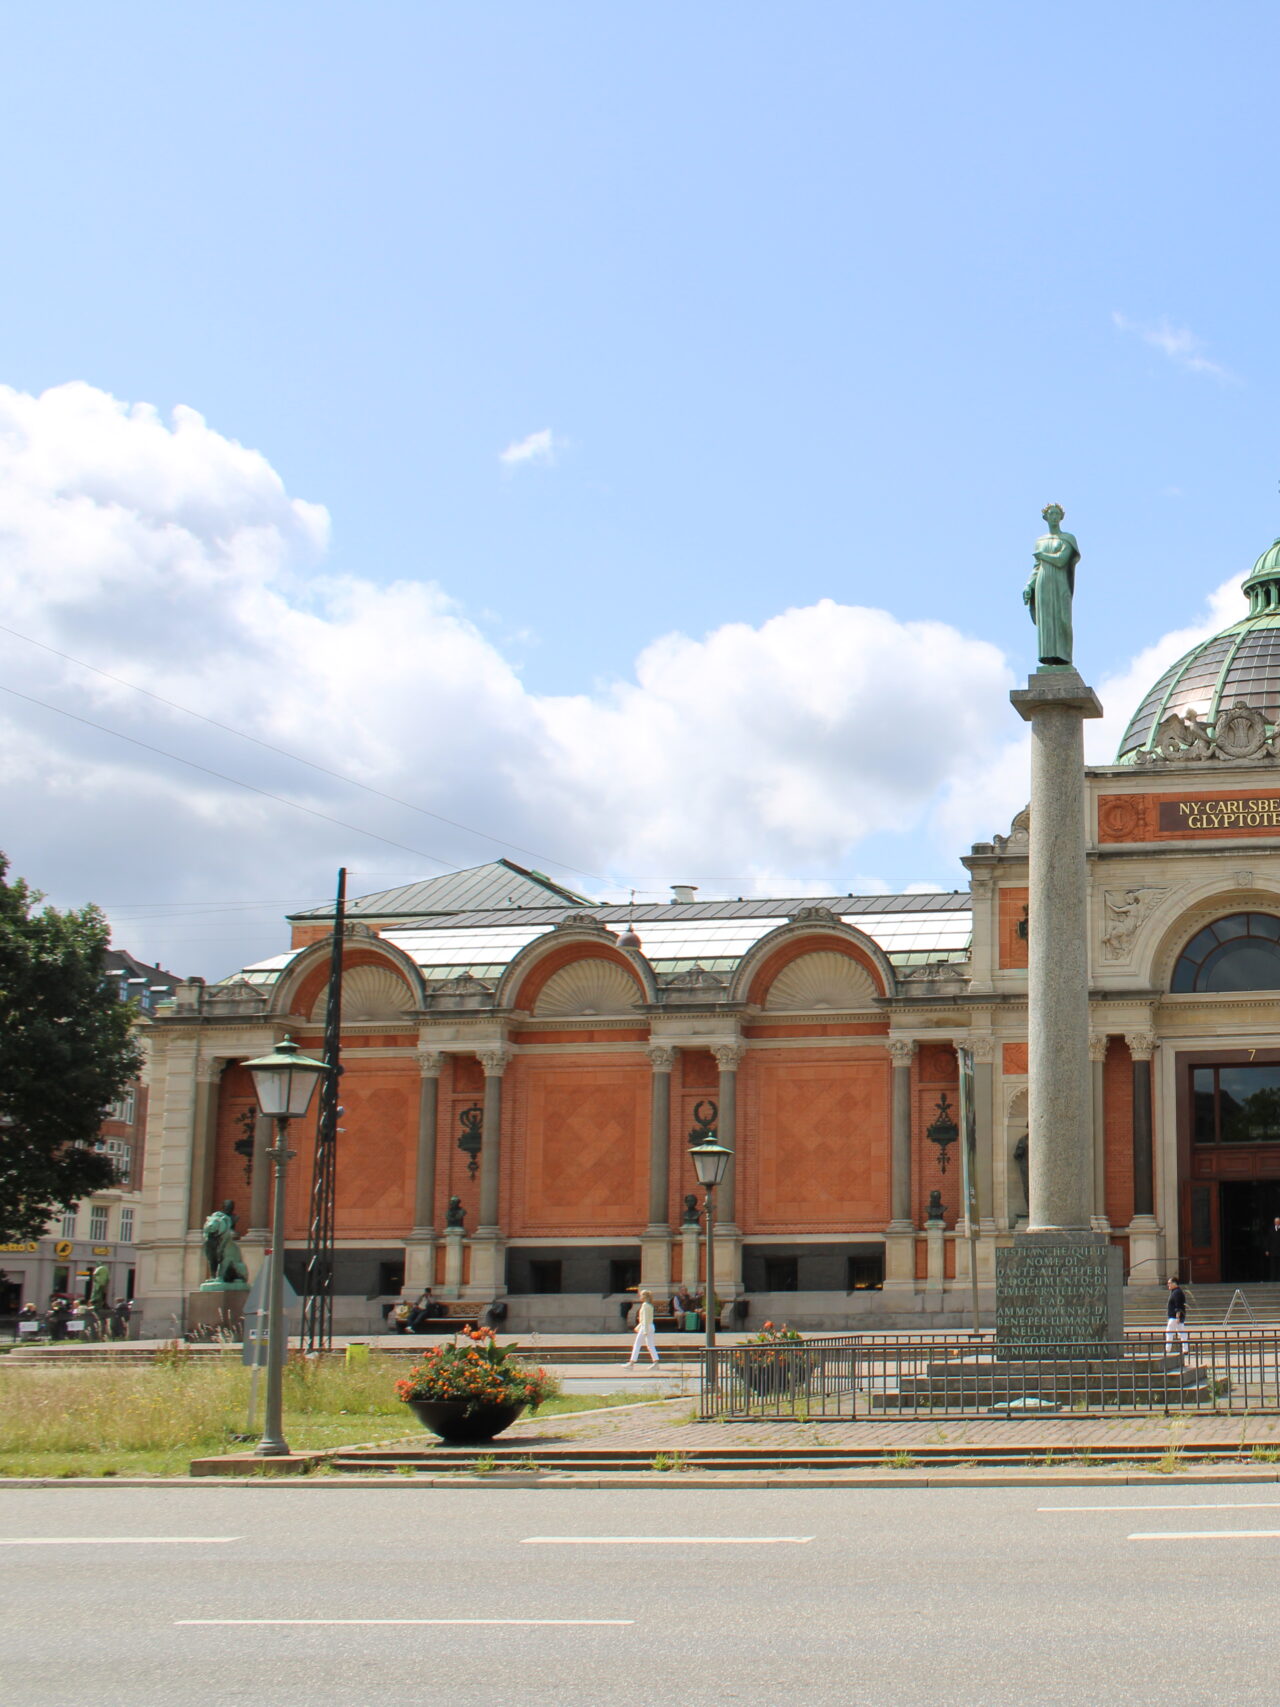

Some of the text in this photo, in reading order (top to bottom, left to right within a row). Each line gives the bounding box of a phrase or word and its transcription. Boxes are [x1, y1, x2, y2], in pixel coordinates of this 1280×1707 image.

[1247, 1049, 1256, 1062] 7
[1026, 1256, 1077, 1266] NOME DI
[1040, 1266, 1107, 1276] ALIGHIERI
[1009, 1276, 1089, 1286] DOCUMENTO
[1095, 1275, 1107, 1285] DI
[997, 1306, 1107, 1316] AMMONIMENTO DI
[997, 1317, 1025, 1326] BENE
[1028, 1317, 1047, 1326] PER
[1011, 1326, 1093, 1336] NELLA INTIMA
